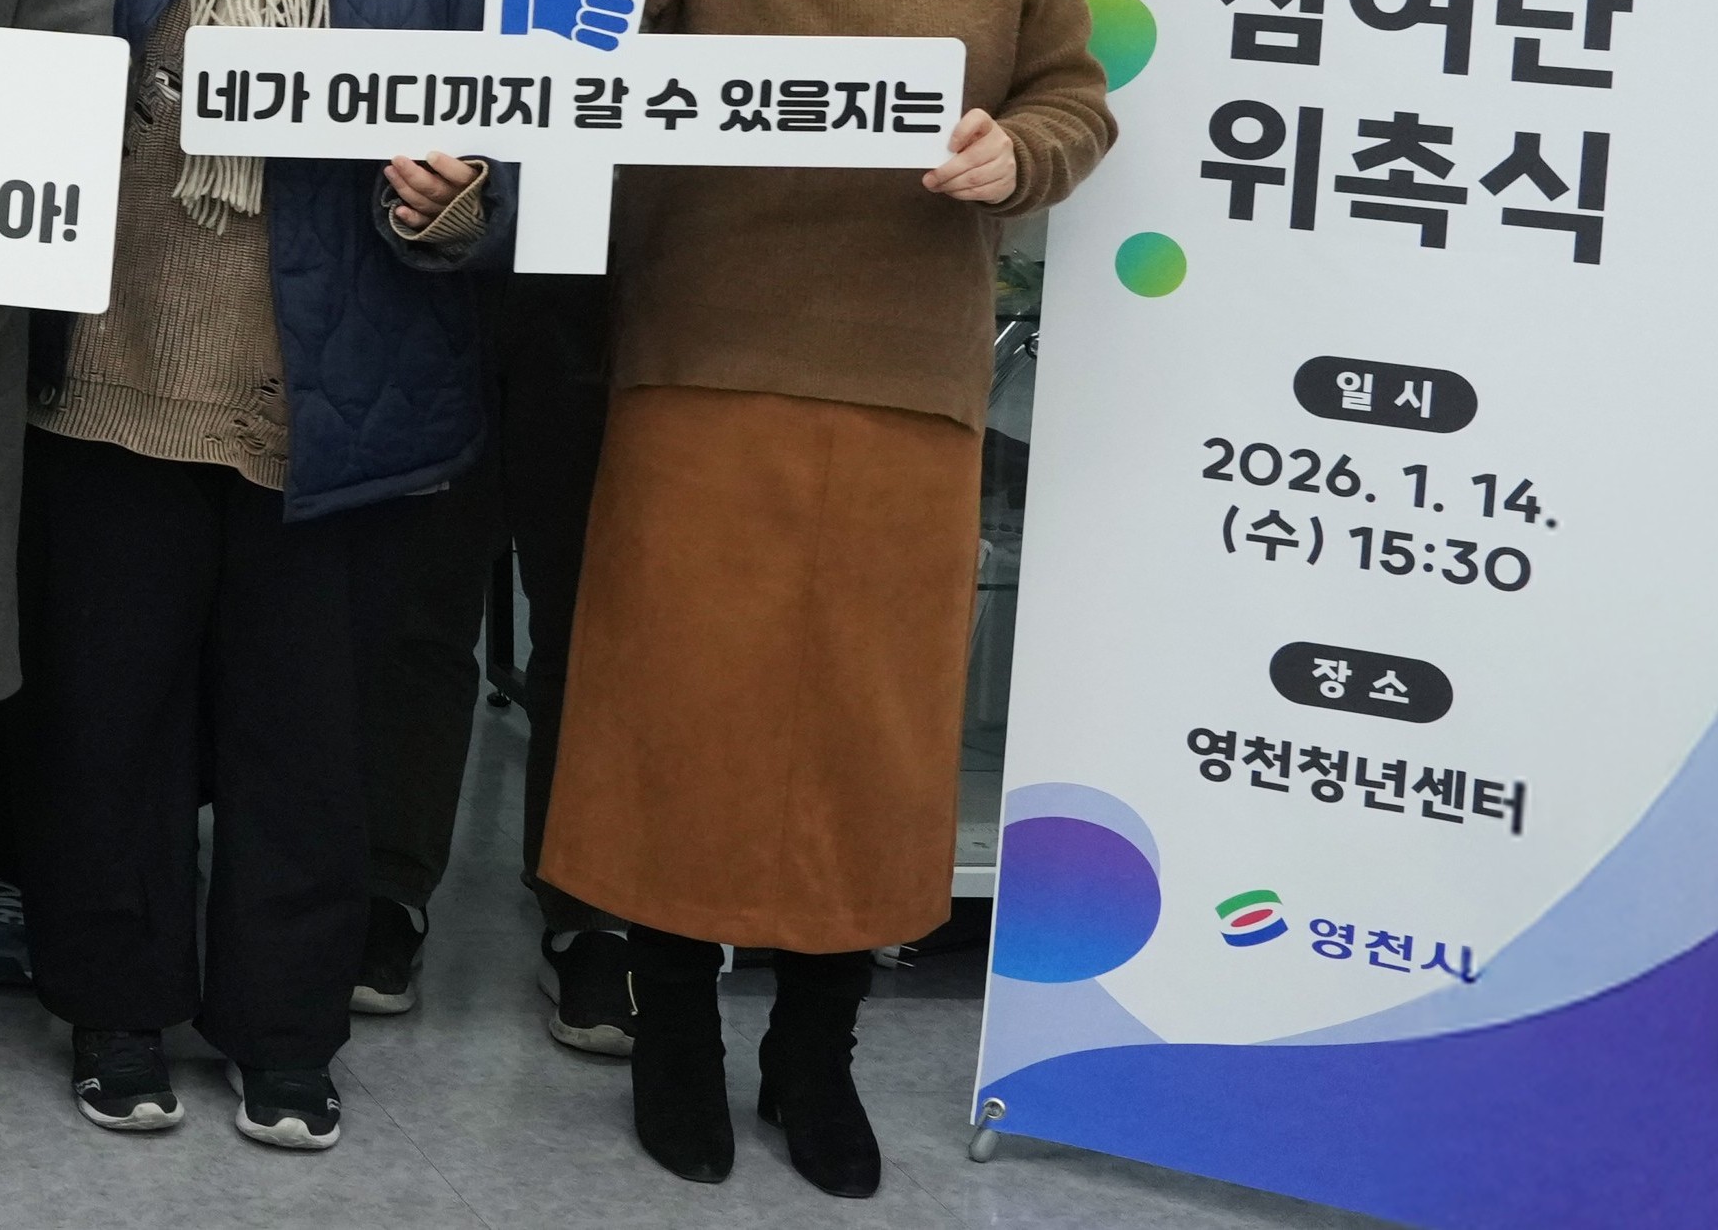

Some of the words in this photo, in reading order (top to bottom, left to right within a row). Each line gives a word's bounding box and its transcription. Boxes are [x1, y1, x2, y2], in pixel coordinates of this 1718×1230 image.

[197, 70, 309, 123] 네가
[328, 73, 551, 128] 어디까지
[574, 78, 629, 129] 갈
[645, 78, 698, 130] 수
[720, 79, 944, 133] 있을지는
[1201, 100, 1610, 265] 위촉식
[1203, 438, 1375, 502] 2026.
[1403, 465, 1443, 512] 1.
[1472, 474, 1556, 528] 14.
[1223, 505, 1323, 565] (수)
[1349, 526, 1532, 592] 15:30
[1187, 727, 1527, 836] 영천청년센터
[1310, 919, 1479, 984] 영천시
